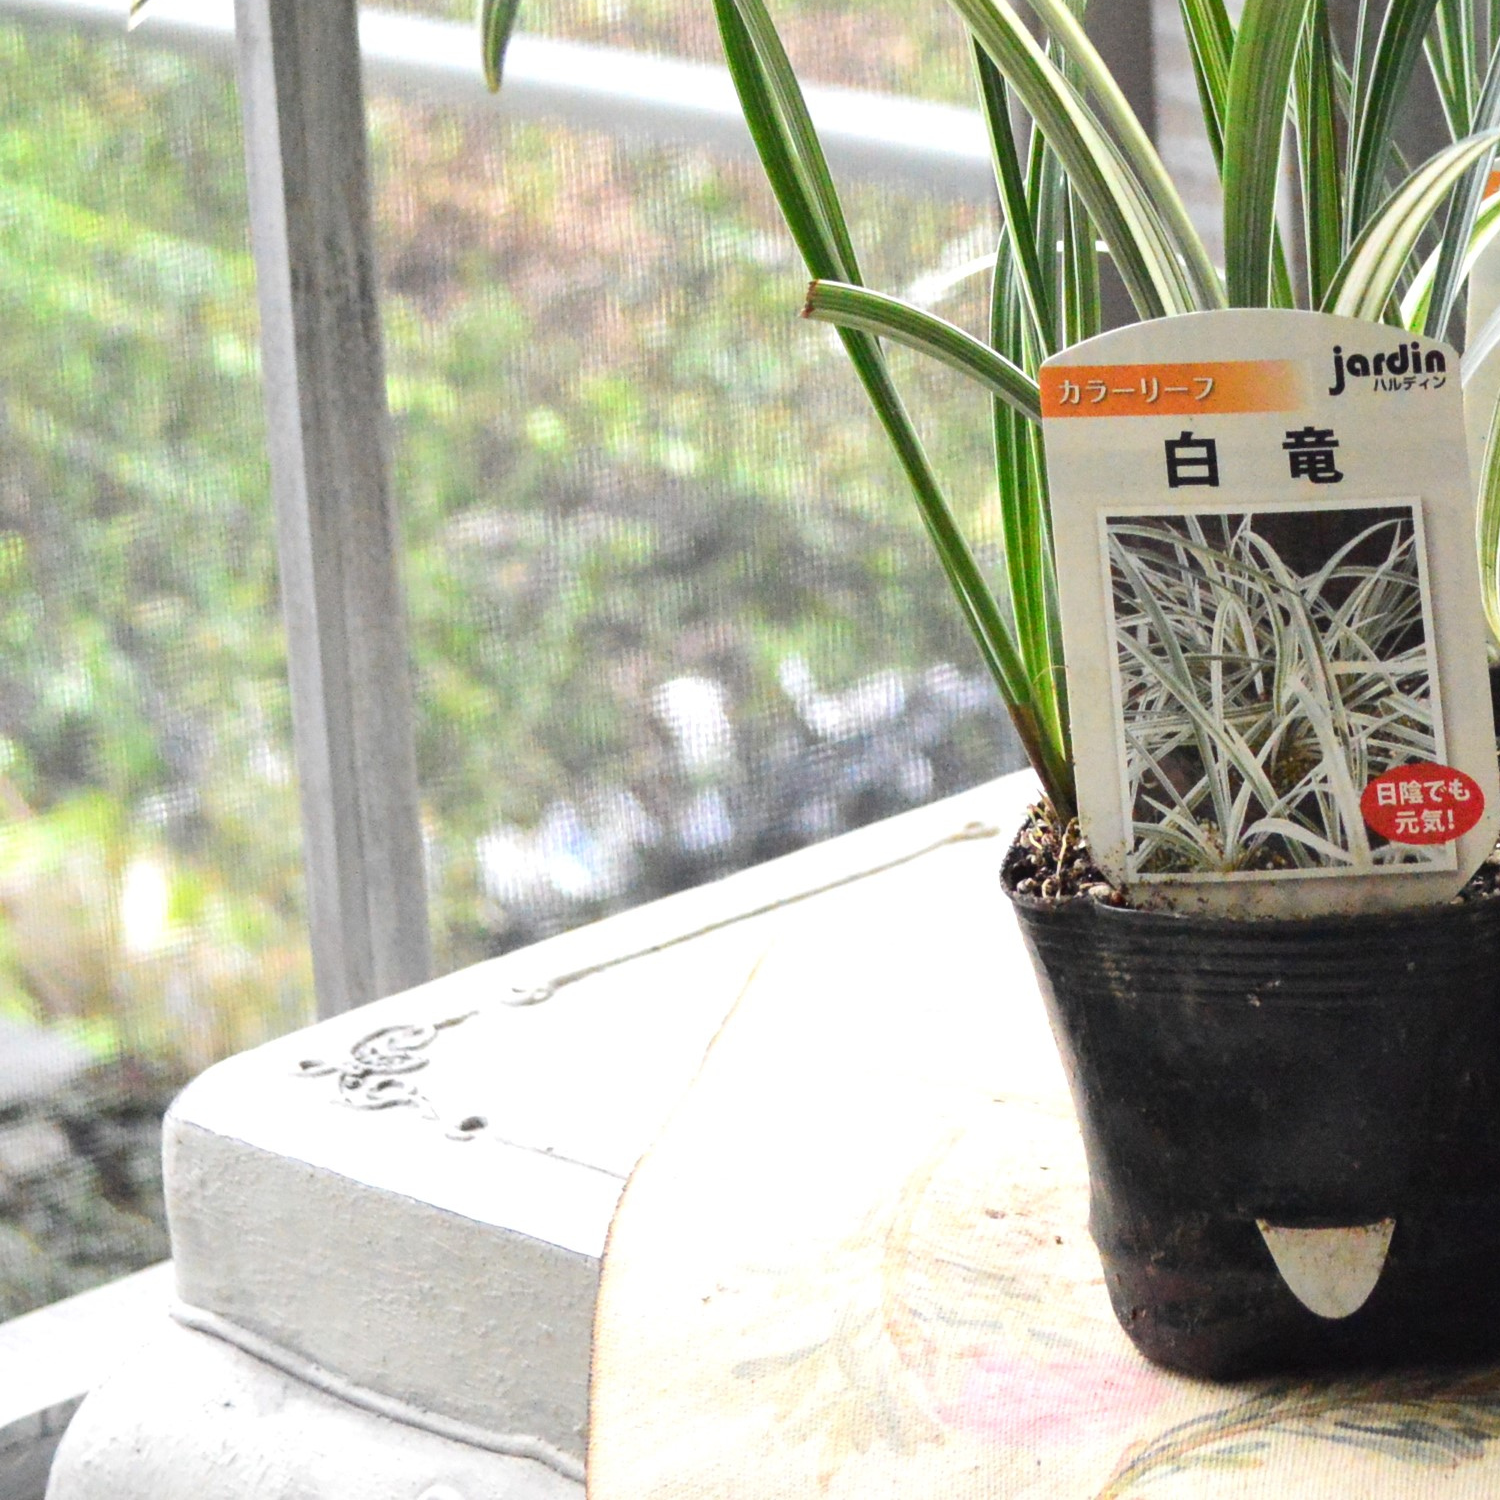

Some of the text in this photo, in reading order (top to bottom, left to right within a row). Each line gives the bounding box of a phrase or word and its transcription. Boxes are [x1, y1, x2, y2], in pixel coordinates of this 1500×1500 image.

[1328, 341, 1446, 396] jardin
[1058, 376, 1214, 404] カラーリーフ
[1373, 376, 1446, 391] ハルディン
[1376, 778, 1471, 806] 日陰でも
[1395, 809, 1454, 835] 元気!
